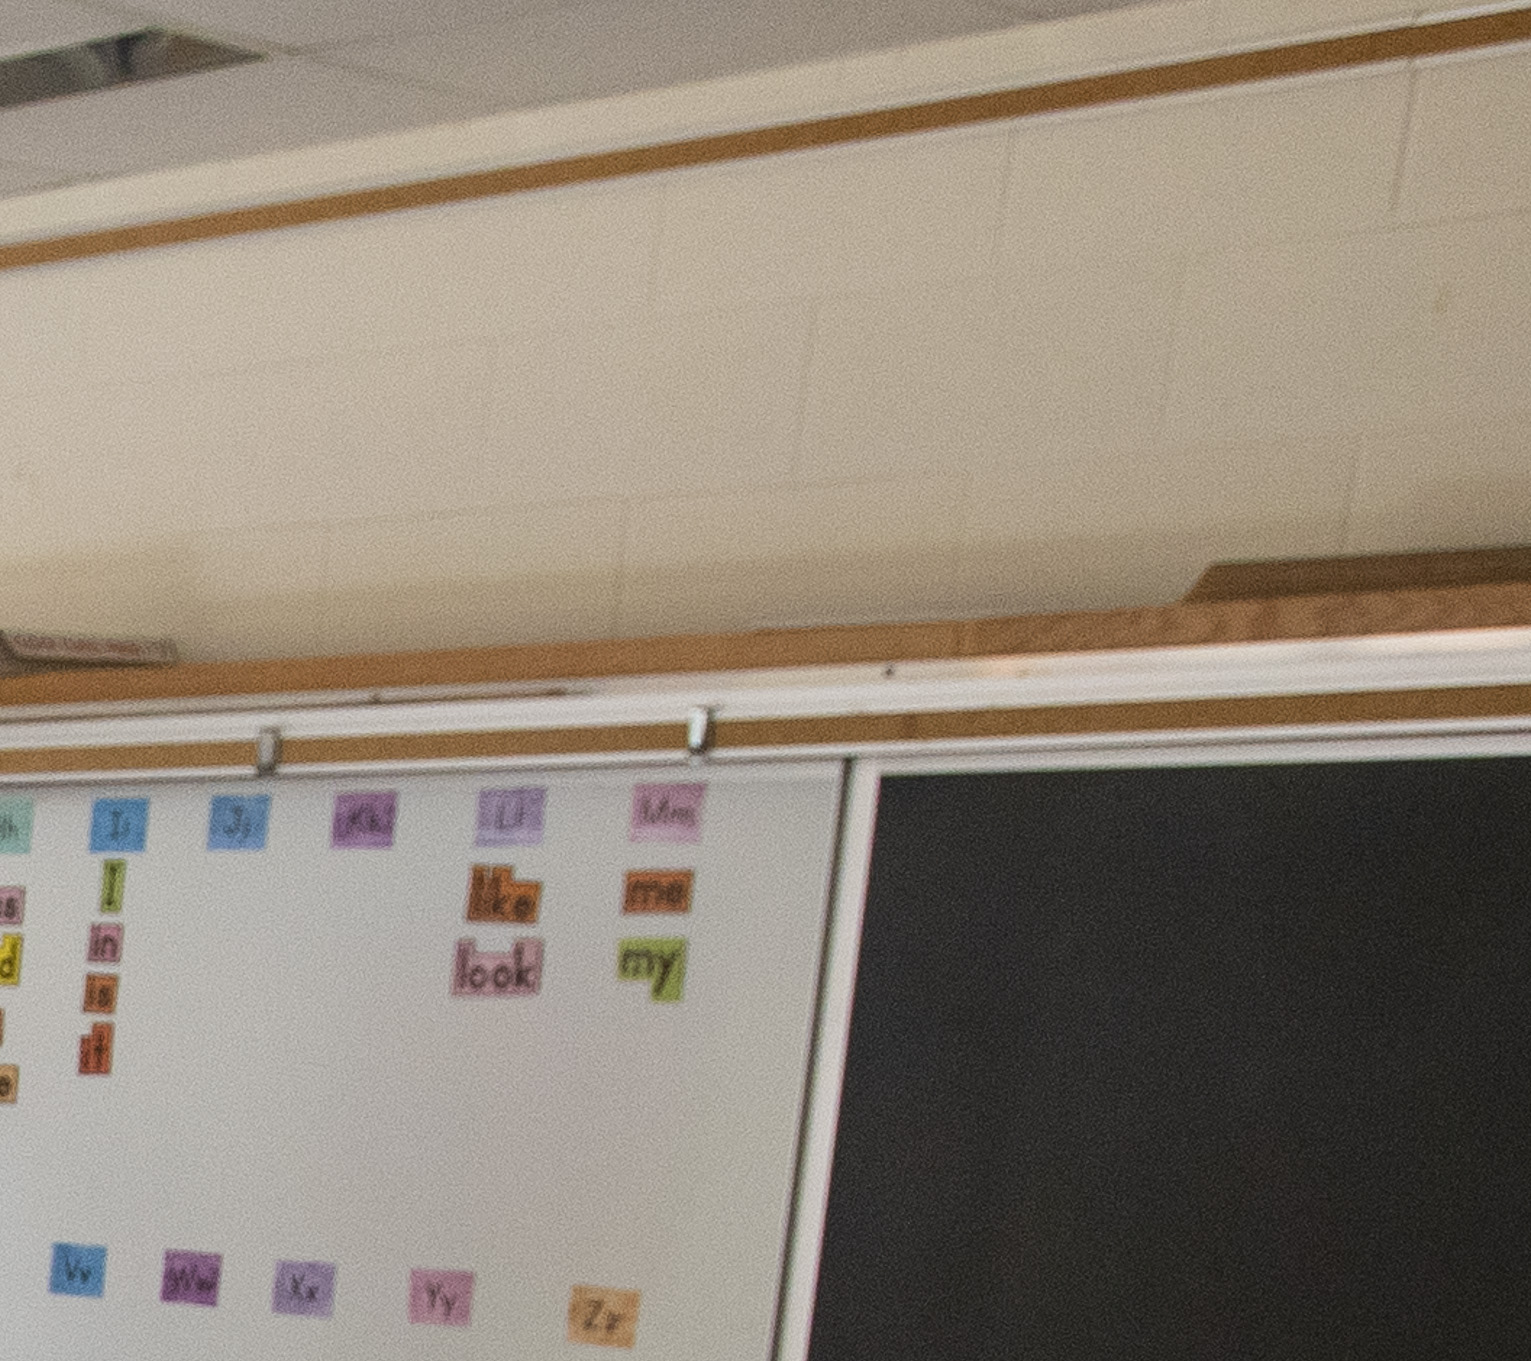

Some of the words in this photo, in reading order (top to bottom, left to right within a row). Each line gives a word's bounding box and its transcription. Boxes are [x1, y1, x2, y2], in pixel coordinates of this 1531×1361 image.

[469, 869, 537, 919] like
[629, 878, 686, 908] me
[89, 926, 119, 959] in
[456, 941, 534, 990] look
[619, 947, 679, 997] my
